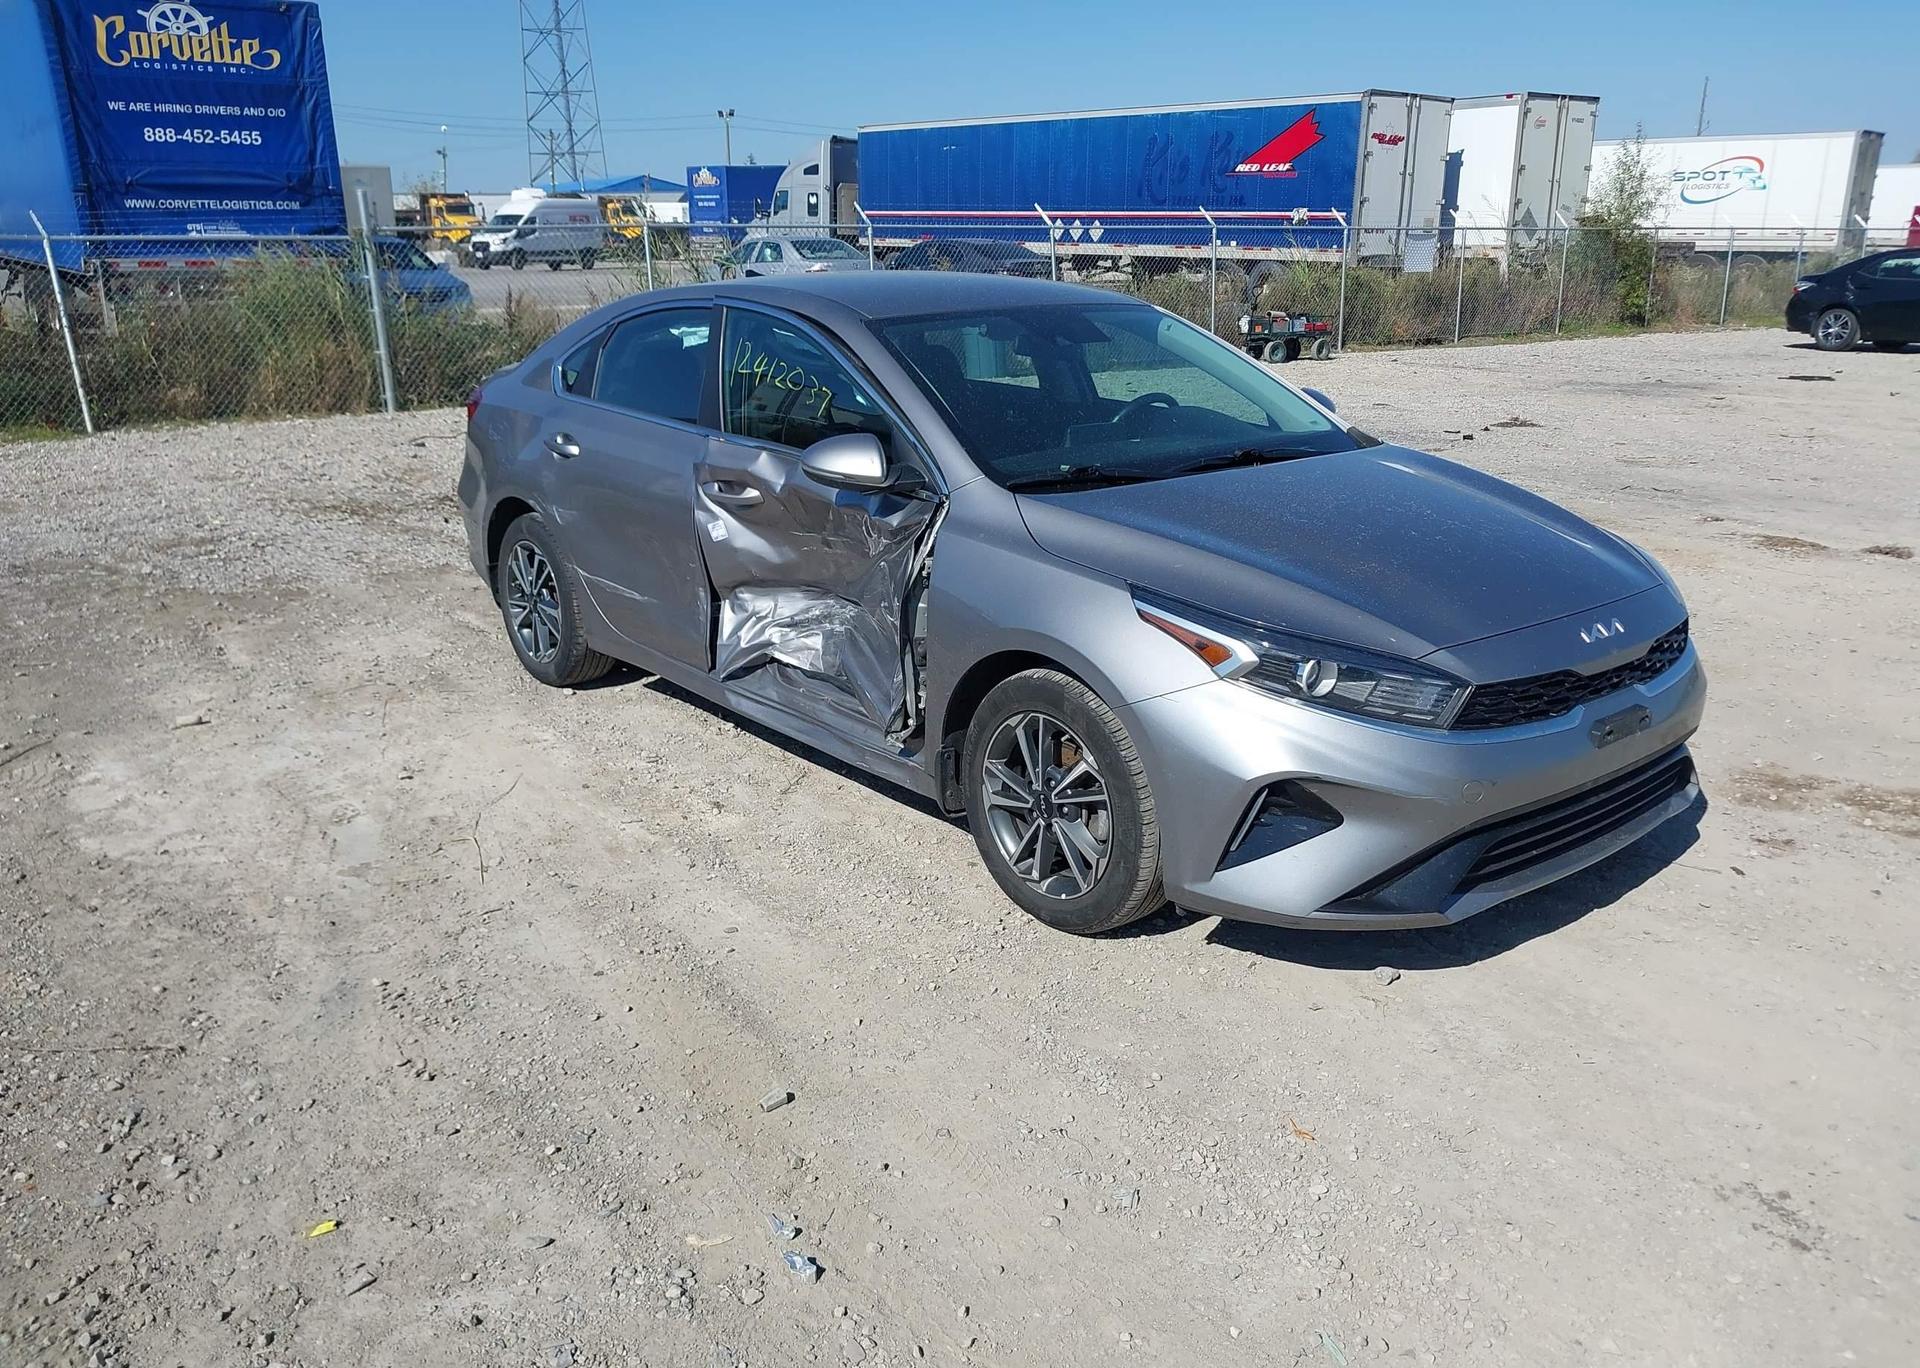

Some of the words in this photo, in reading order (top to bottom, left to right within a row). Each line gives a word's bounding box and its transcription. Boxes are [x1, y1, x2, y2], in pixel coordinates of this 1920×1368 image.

[93, 14, 281, 71] Corvette
[133, 61, 214, 73] LOGISTICS
[223, 66, 254, 75] INC.
[107, 101, 126, 111] WE
[129, 102, 152, 112] ARE
[154, 103, 193, 114] HIRING
[195, 104, 241, 116] DRIVERS
[243, 107, 266, 117] AND
[267, 107, 286, 118] O/O
[143, 127, 262, 145] 888-452-5455
[1234, 163, 1260, 172] RED
[1262, 162, 1294, 172] LEAF
[1685, 182, 1731, 191] LOGISTICS
[123, 198, 300, 210] WWW.CORVETTELOGISTICS.COM
